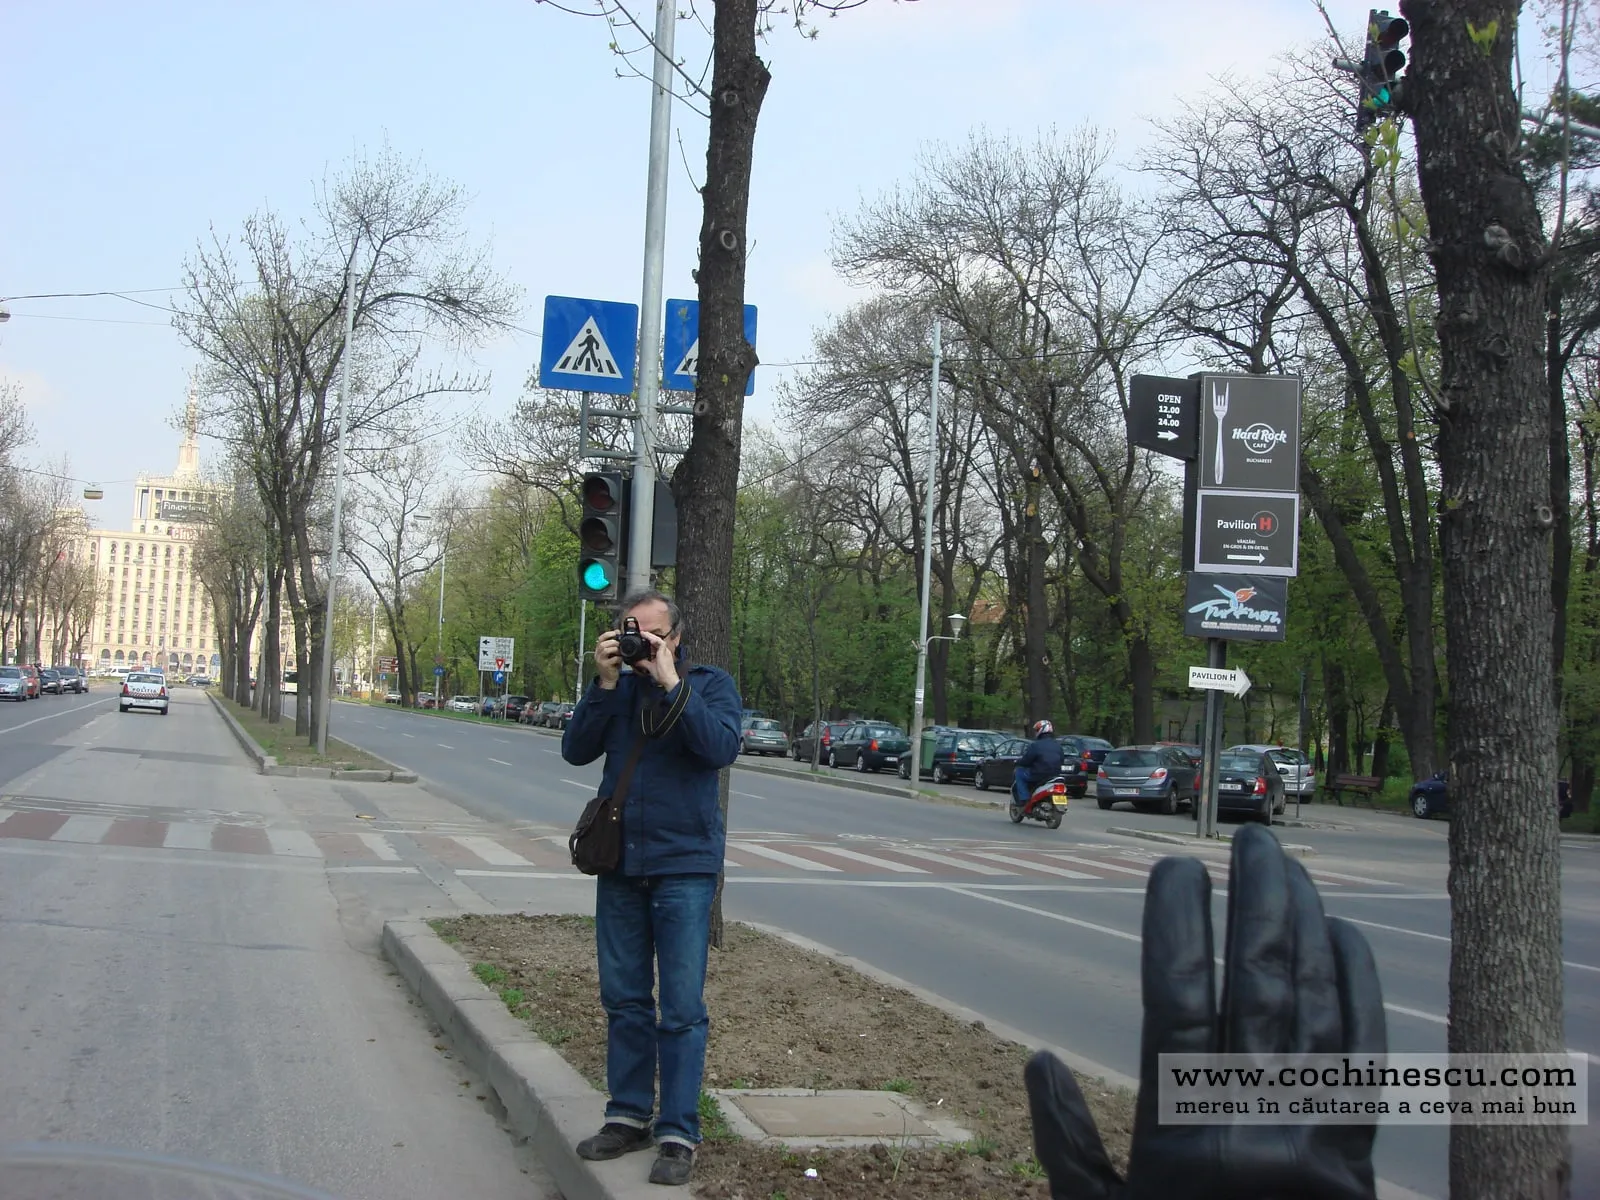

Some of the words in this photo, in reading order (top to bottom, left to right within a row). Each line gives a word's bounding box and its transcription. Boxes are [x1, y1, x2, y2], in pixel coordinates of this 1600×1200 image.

[1157, 394, 1181, 403] OPEN
[1158, 405, 1180, 414] 12.00
[1158, 418, 1180, 427] 24.00
[1232, 428, 1260, 440] Hard
[1260, 429, 1287, 443] Rock
[1217, 519, 1257, 530] Pavilion
[1259, 516, 1272, 531] H
[1191, 671, 1228, 681] PAVILION
[1229, 673, 1237, 682] H
